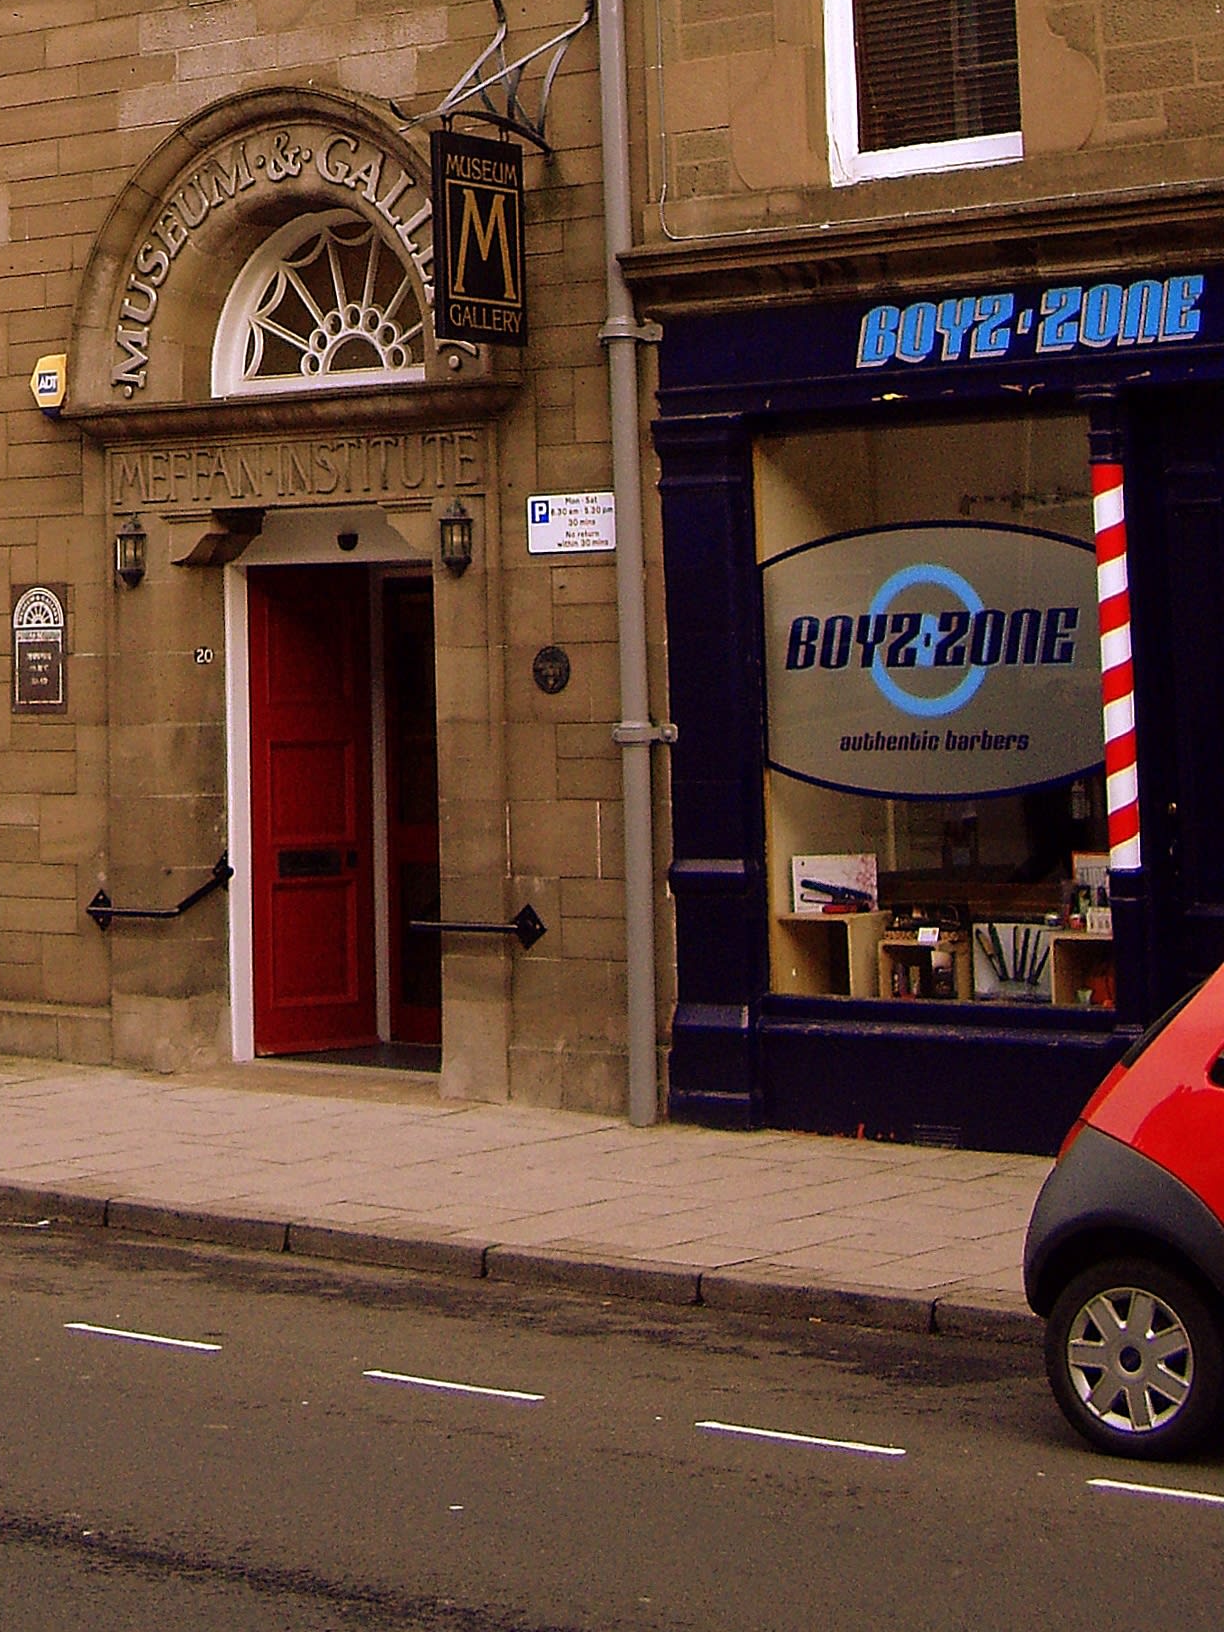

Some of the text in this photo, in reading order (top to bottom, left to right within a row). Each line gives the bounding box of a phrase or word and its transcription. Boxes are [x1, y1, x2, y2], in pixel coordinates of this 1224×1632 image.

[446, 154, 519, 186] MUSEUM
[454, 189, 517, 299] M
[111, 142, 256, 389] MUSEUM
[449, 304, 523, 333] GALLERY
[38, 375, 58, 389] ADT
[276, 435, 480, 496] INSTITUTE
[535, 502, 547, 522] P
[196, 648, 213, 663] 20
[840, 730, 1030, 751] authentic barbers
